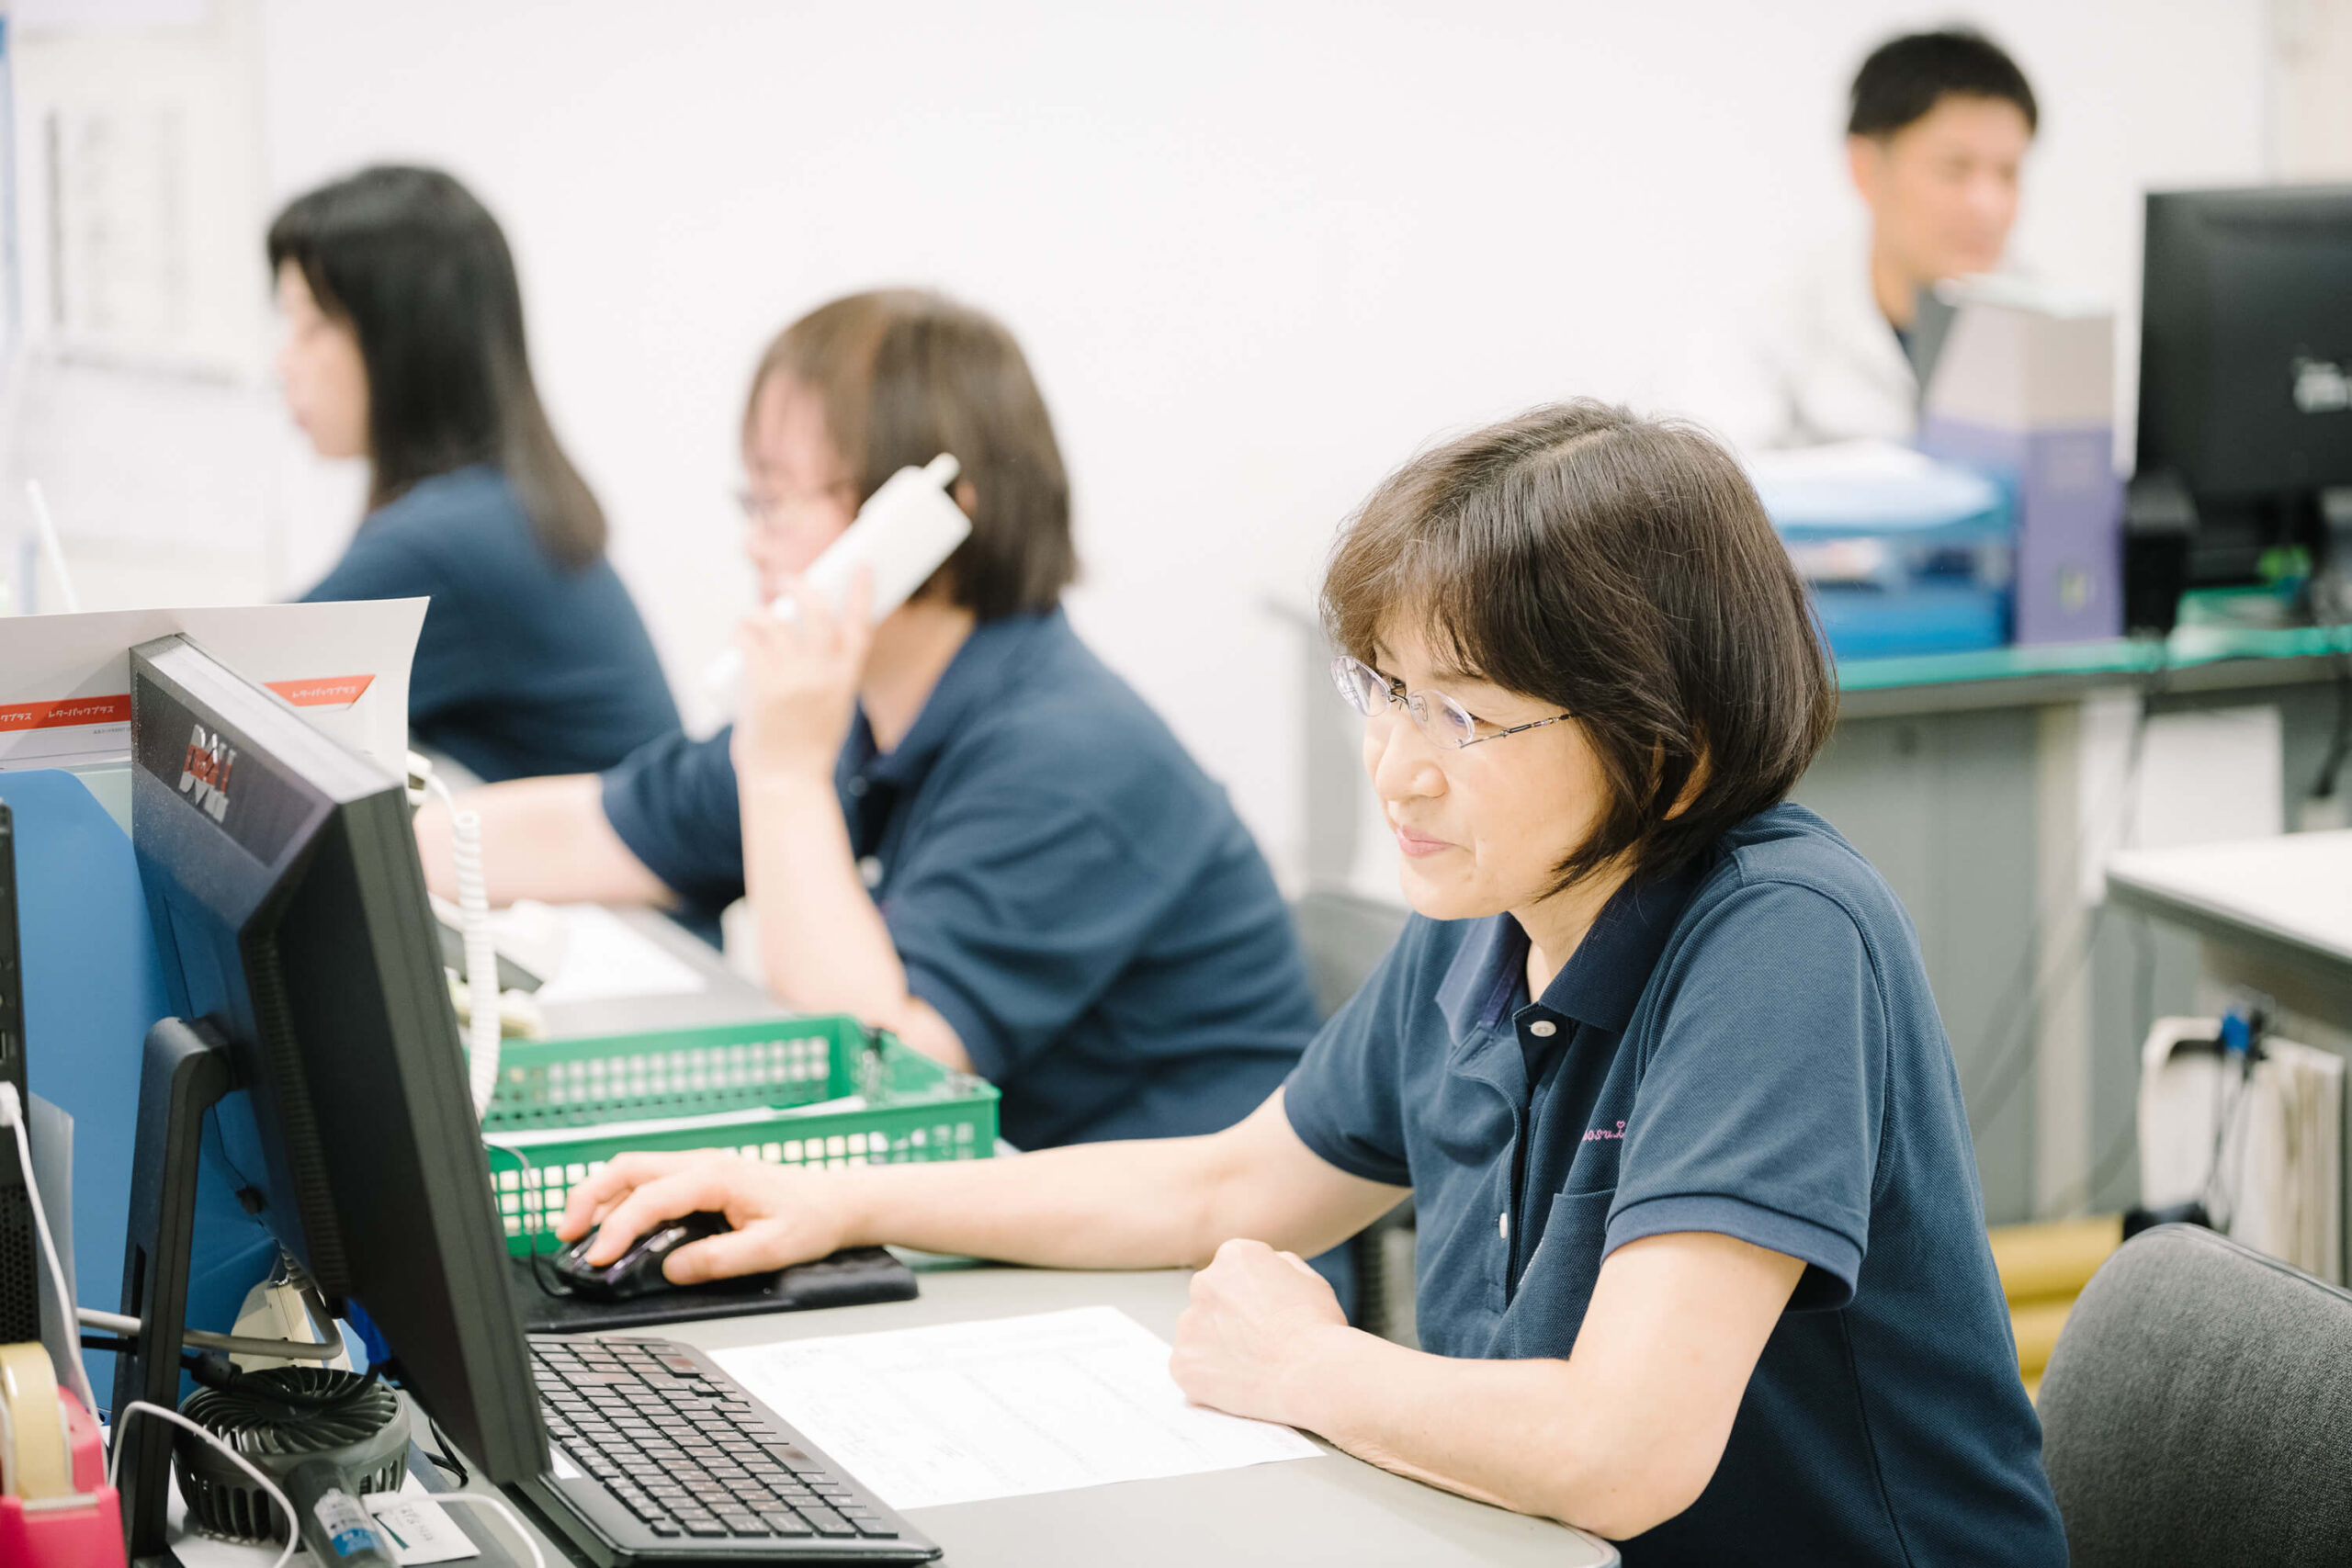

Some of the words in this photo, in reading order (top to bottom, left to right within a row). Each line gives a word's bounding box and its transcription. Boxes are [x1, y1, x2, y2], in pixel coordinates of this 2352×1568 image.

[49, 705, 115, 717] レターパックプラス
